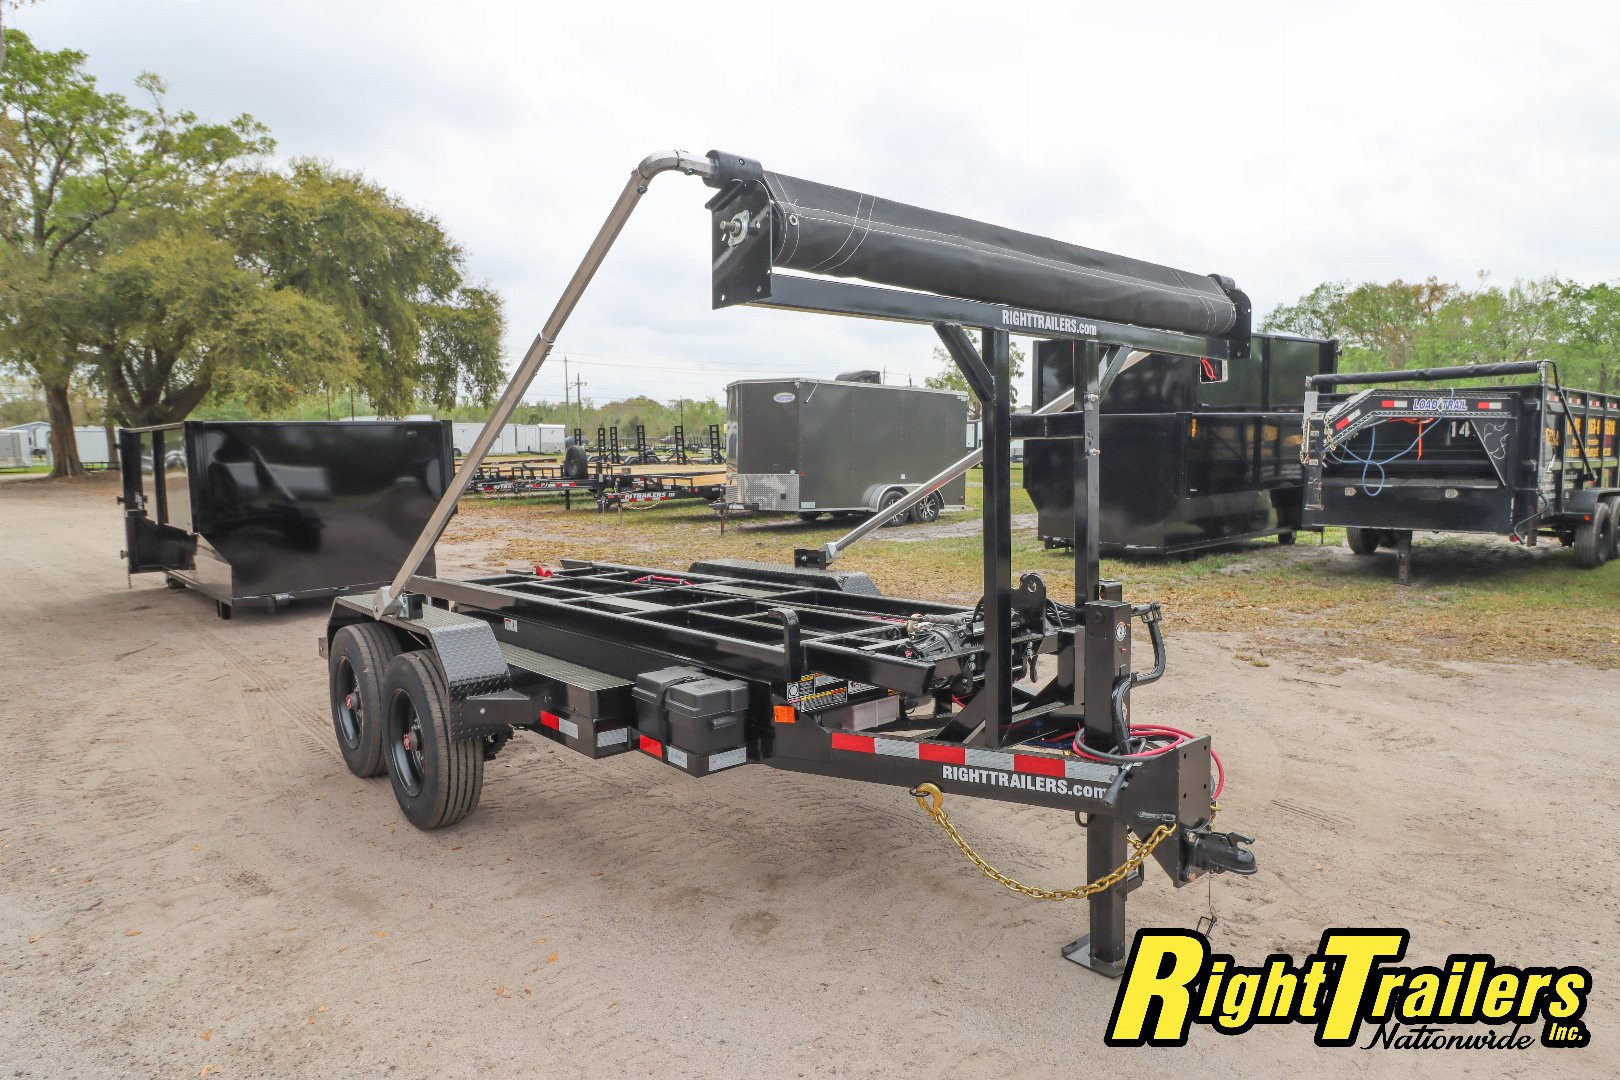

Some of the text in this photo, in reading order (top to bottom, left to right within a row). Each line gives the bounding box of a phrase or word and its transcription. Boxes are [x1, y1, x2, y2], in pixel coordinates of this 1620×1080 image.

[1002, 309, 1097, 336] RIGHTTRAILERS.com
[1413, 398, 1468, 412] LOAD TRAIL
